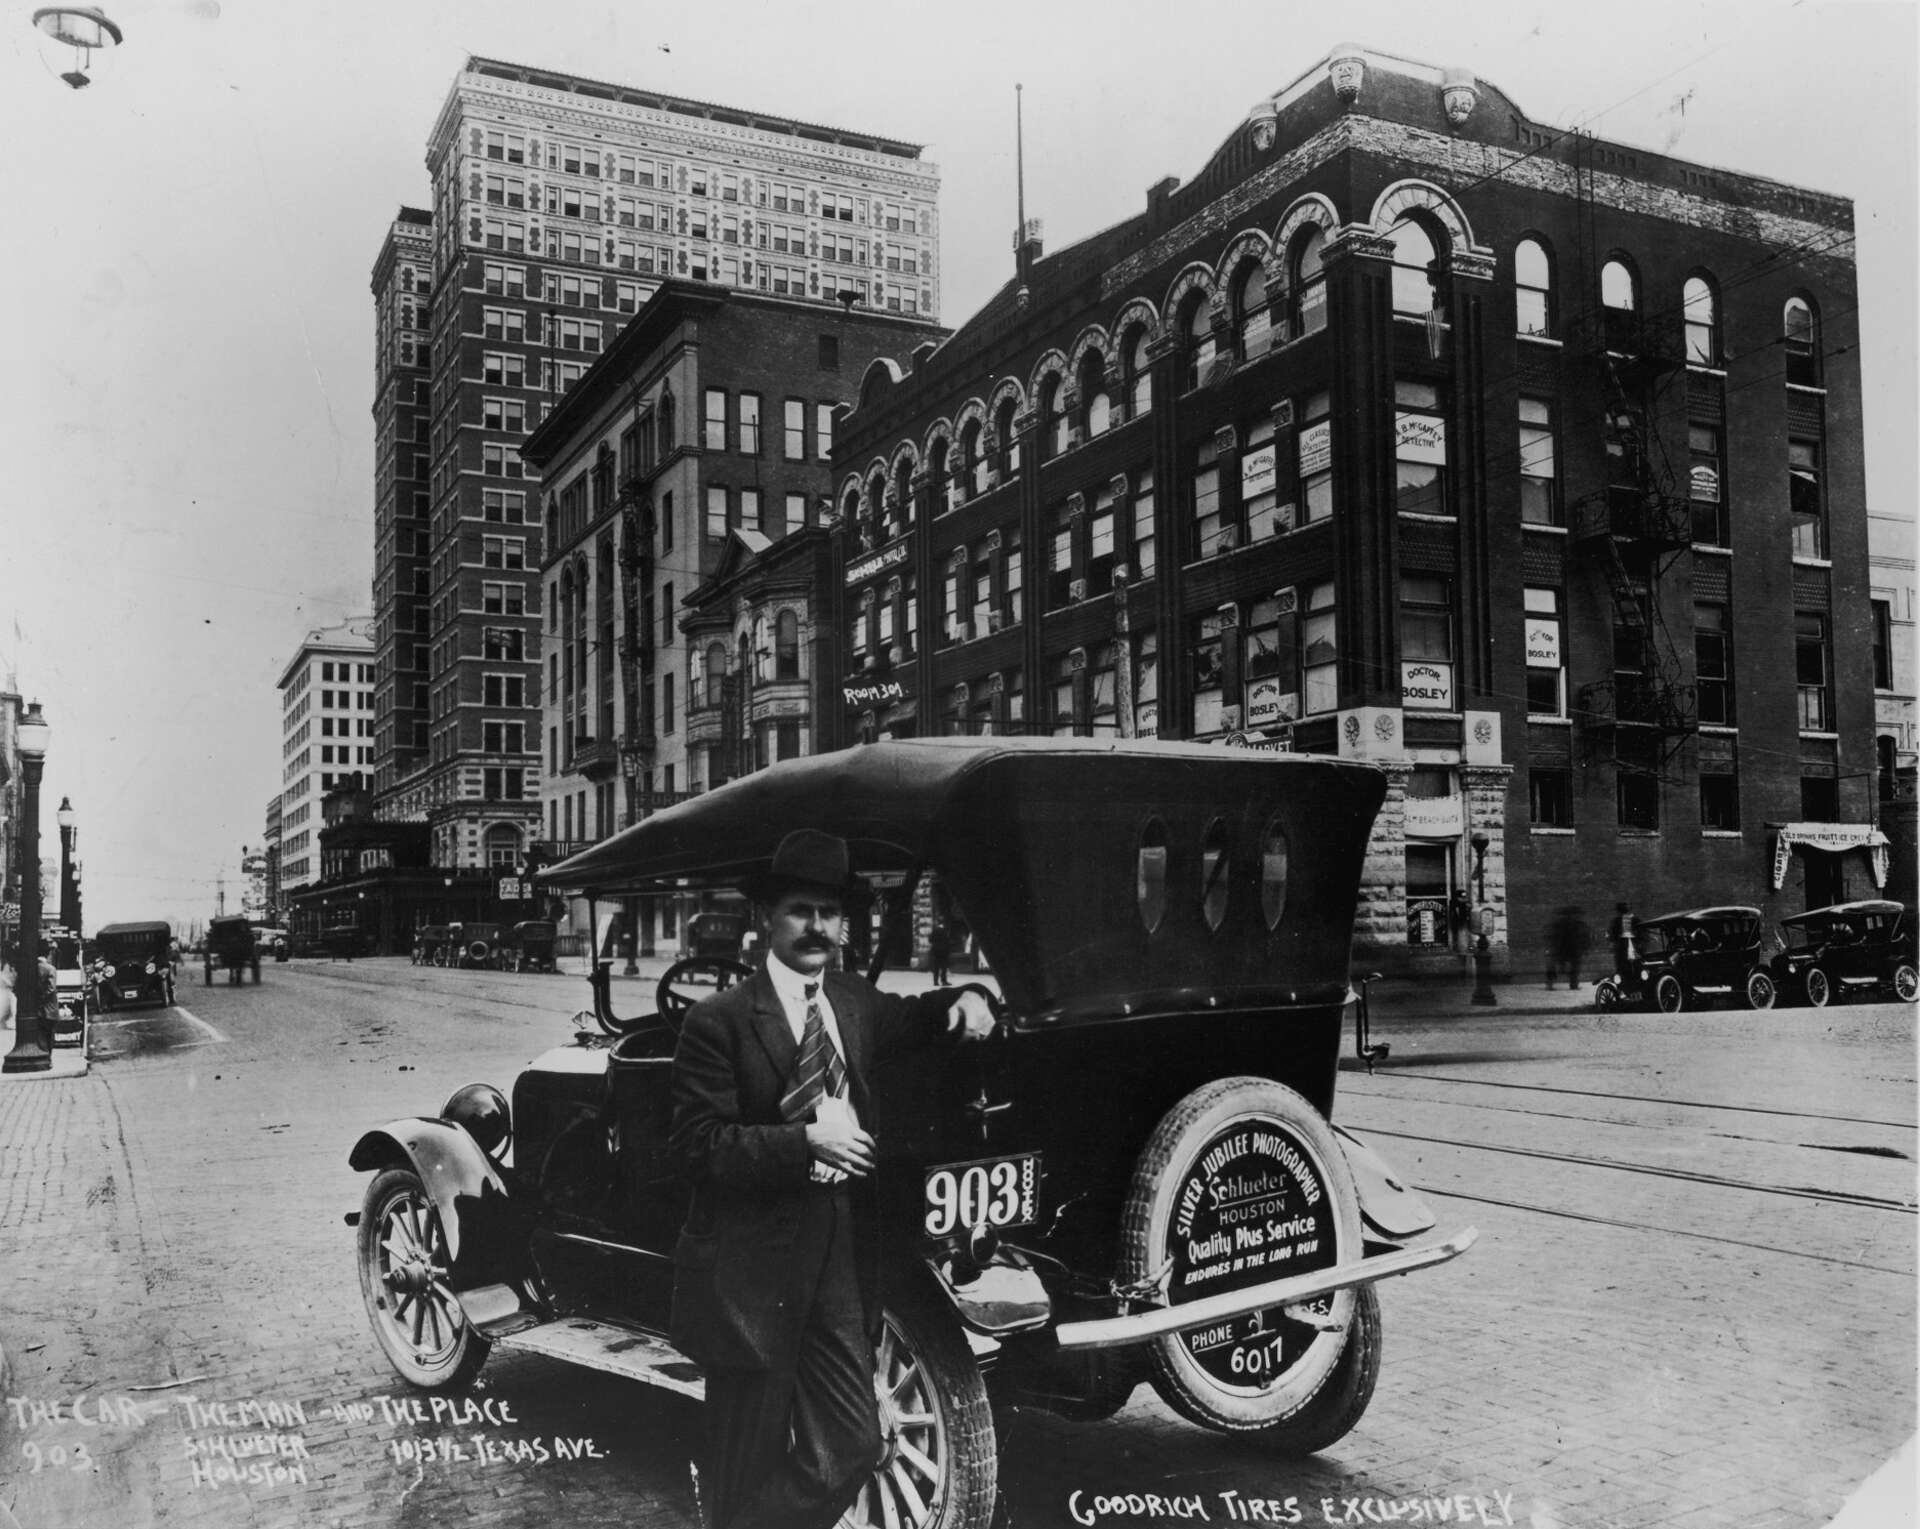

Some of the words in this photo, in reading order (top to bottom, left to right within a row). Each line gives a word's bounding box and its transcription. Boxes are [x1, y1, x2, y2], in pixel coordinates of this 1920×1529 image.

[1527, 649, 1557, 659] BOSLEY
[1407, 666, 1441, 682] DOCTOR
[1252, 684, 1278, 700] DOCTOR
[1401, 686, 1448, 700] BOSLEY
[925, 1162, 1019, 1235] 903
[1176, 1178, 1205, 1238] SILVER
[1202, 1133, 1249, 1182] JUBILEE
[1252, 1131, 1321, 1207] PHOTOGRAPHER
[1209, 1170, 1287, 1211] Schlueter
[1218, 1198, 1286, 1226] HOUSTON
[1188, 1231, 1232, 1265] Quality
[1235, 1226, 1264, 1250] Plus
[1266, 1214, 1316, 1242] Service
[1184, 1261, 1231, 1285] ENDURES
[1232, 1257, 1245, 1272] IN
[1246, 1252, 1266, 1268] THE
[1268, 1245, 1292, 1262] LONG
[1295, 1239, 1319, 1256] RUN
[1191, 1324, 1233, 1350] PHONE
[1230, 1336, 1283, 1374] 6017
